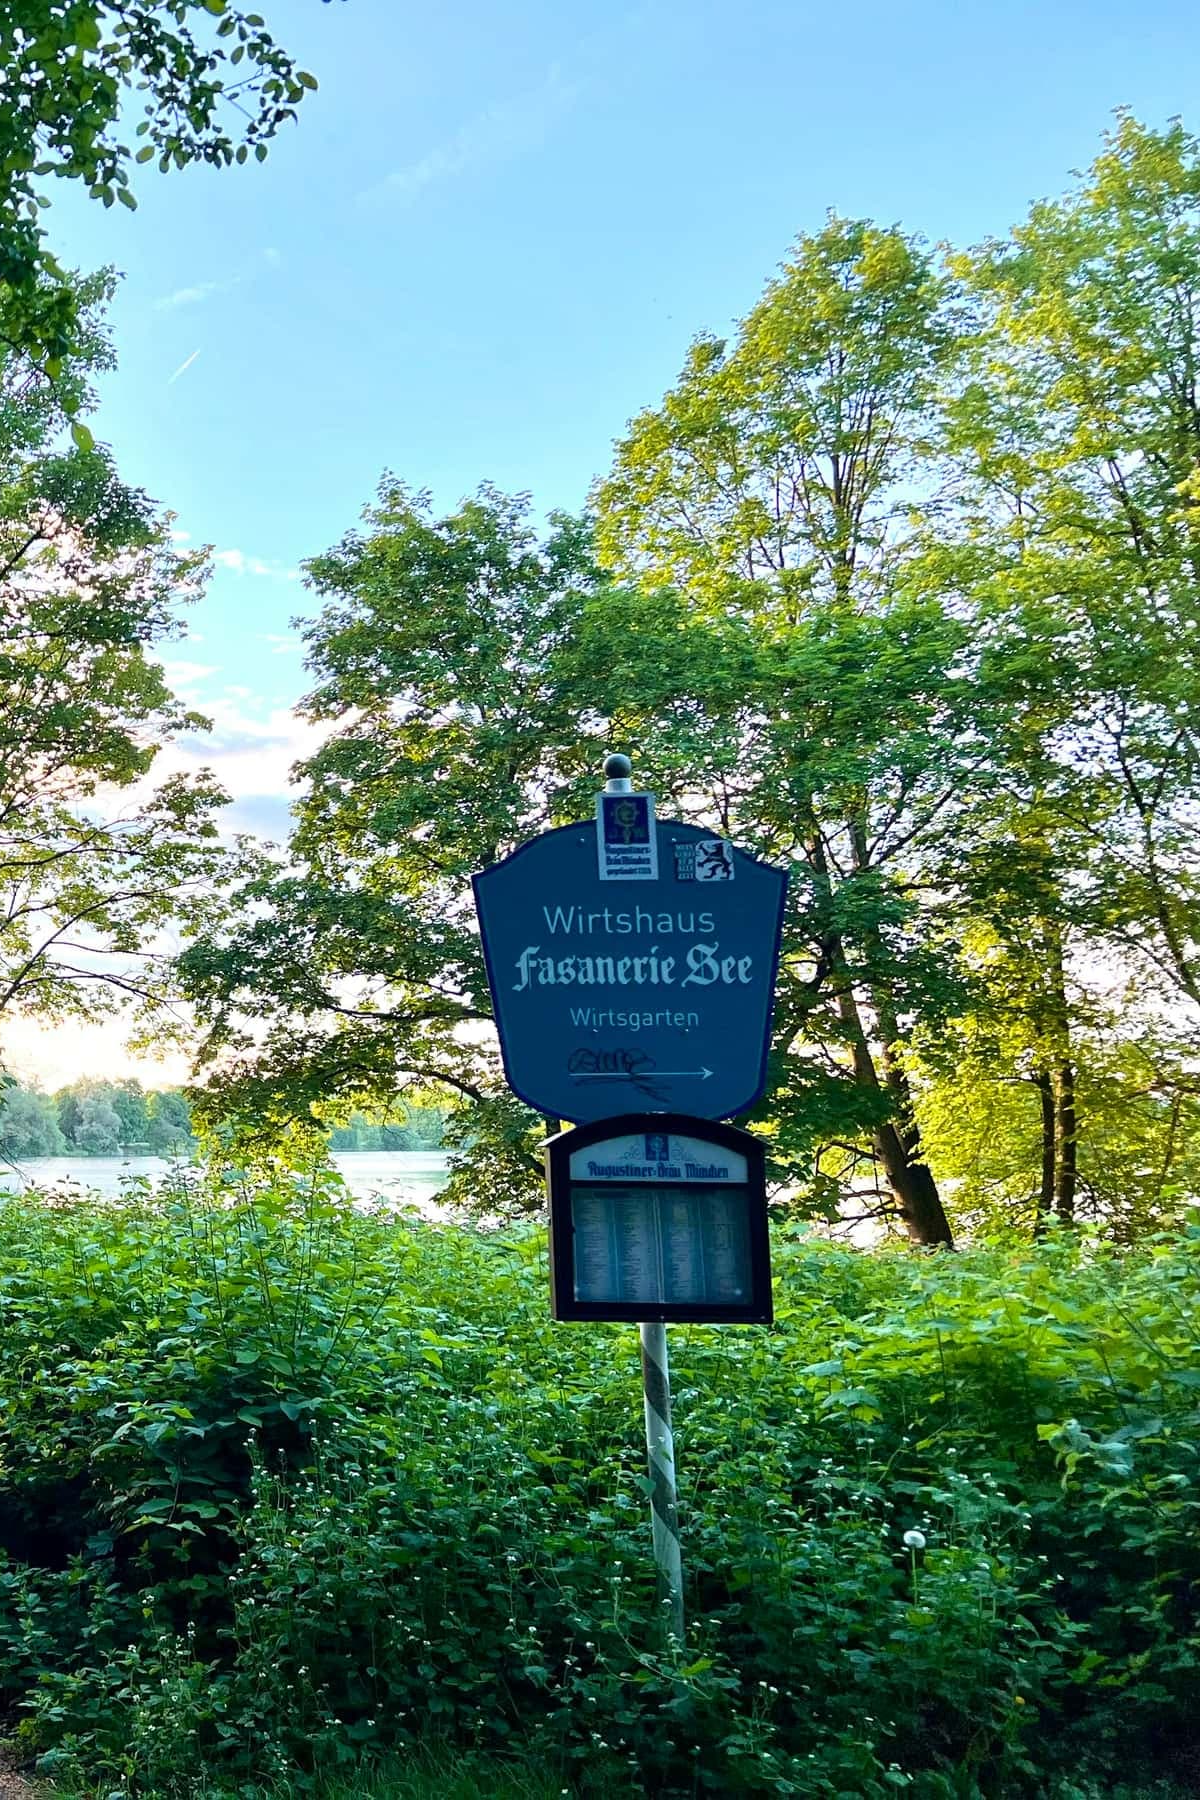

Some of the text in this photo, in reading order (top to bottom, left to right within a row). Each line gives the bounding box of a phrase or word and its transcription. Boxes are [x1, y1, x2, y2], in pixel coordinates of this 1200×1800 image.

[543, 905, 716, 934] Wirtshaus
[512, 942, 753, 992] Fasanerie See
[570, 1007, 700, 1032] Wirtsgarten
[684, 1162, 729, 1178] München
